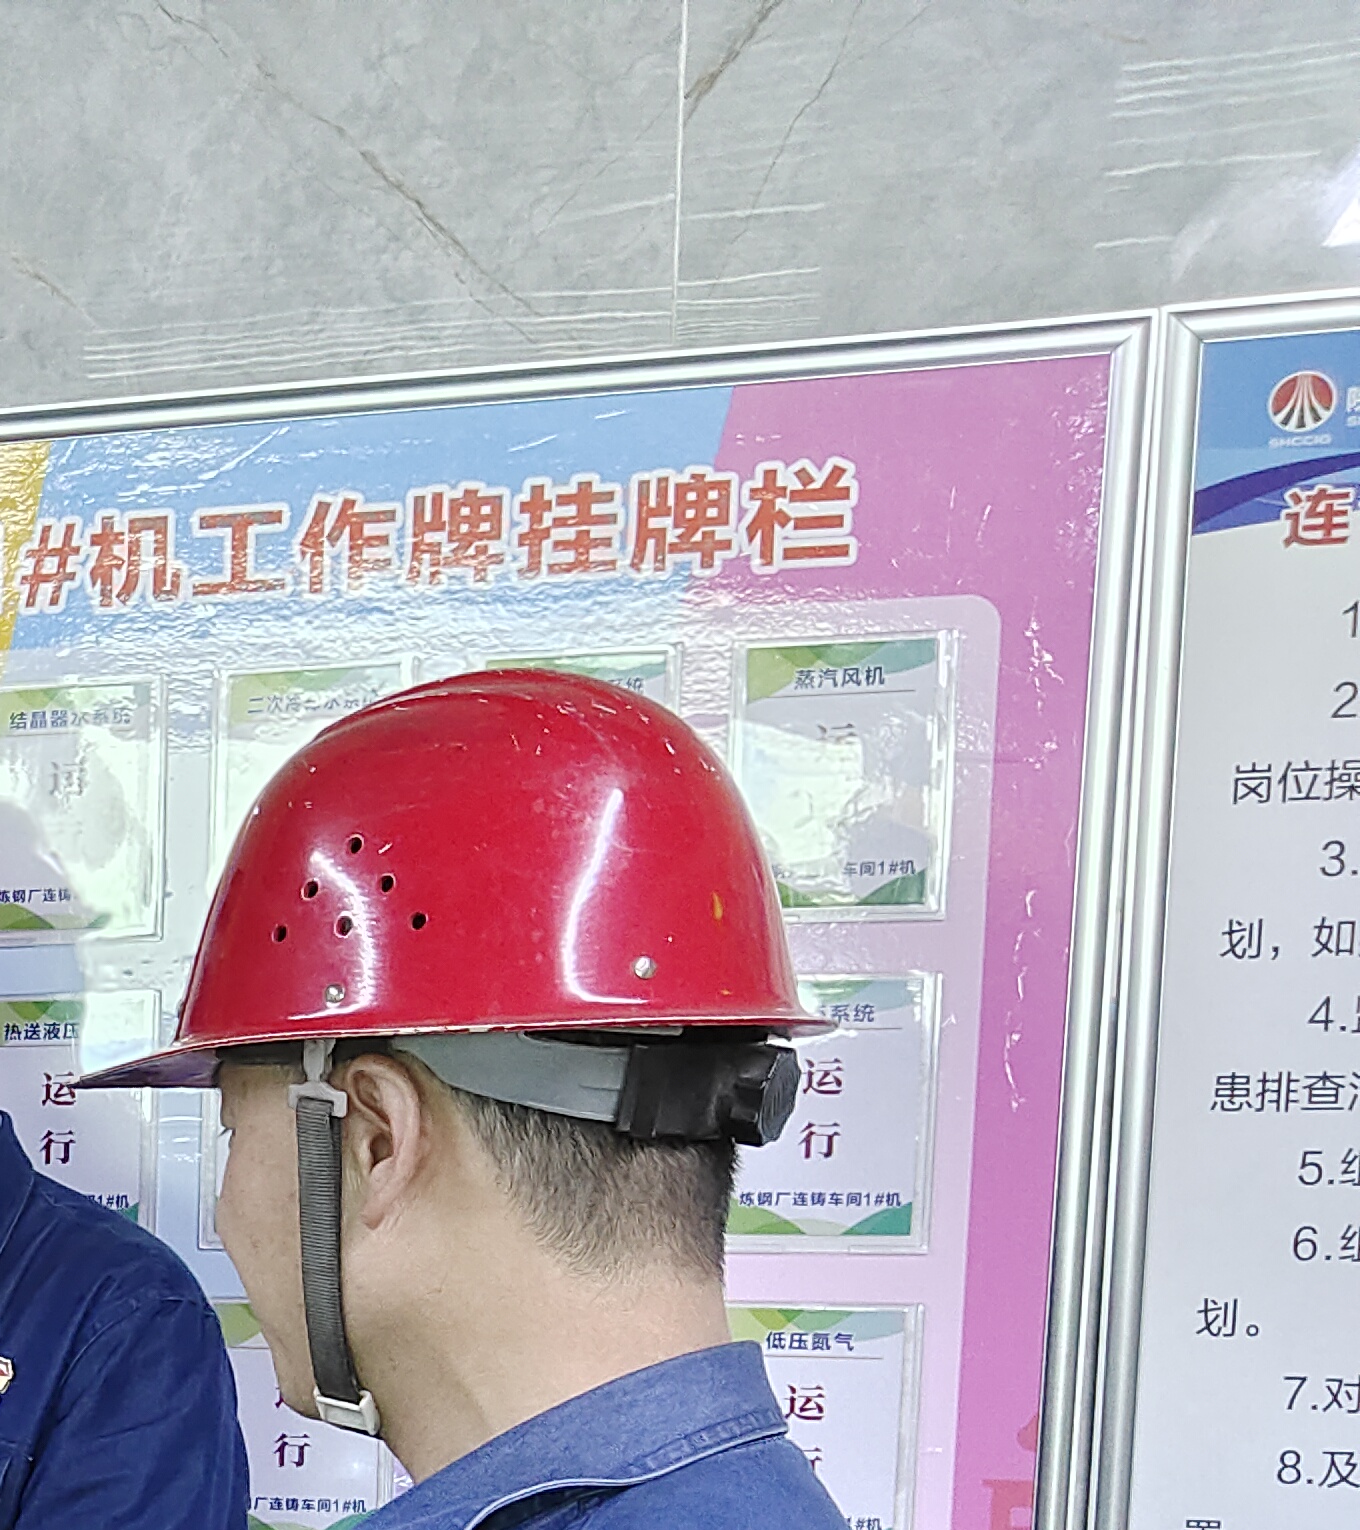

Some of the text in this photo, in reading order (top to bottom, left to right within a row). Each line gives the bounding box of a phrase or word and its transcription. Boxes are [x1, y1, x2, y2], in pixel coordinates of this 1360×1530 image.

[1283, 487, 1351, 549] 连
[793, 665, 886, 690] 蒸汽风机
[1306, 995, 1360, 1034] 4.
[739, 1191, 902, 1208] 炼钢厂连铸车间1#机
[249, 1496, 367, 1514] 厂连铸车间1#机
